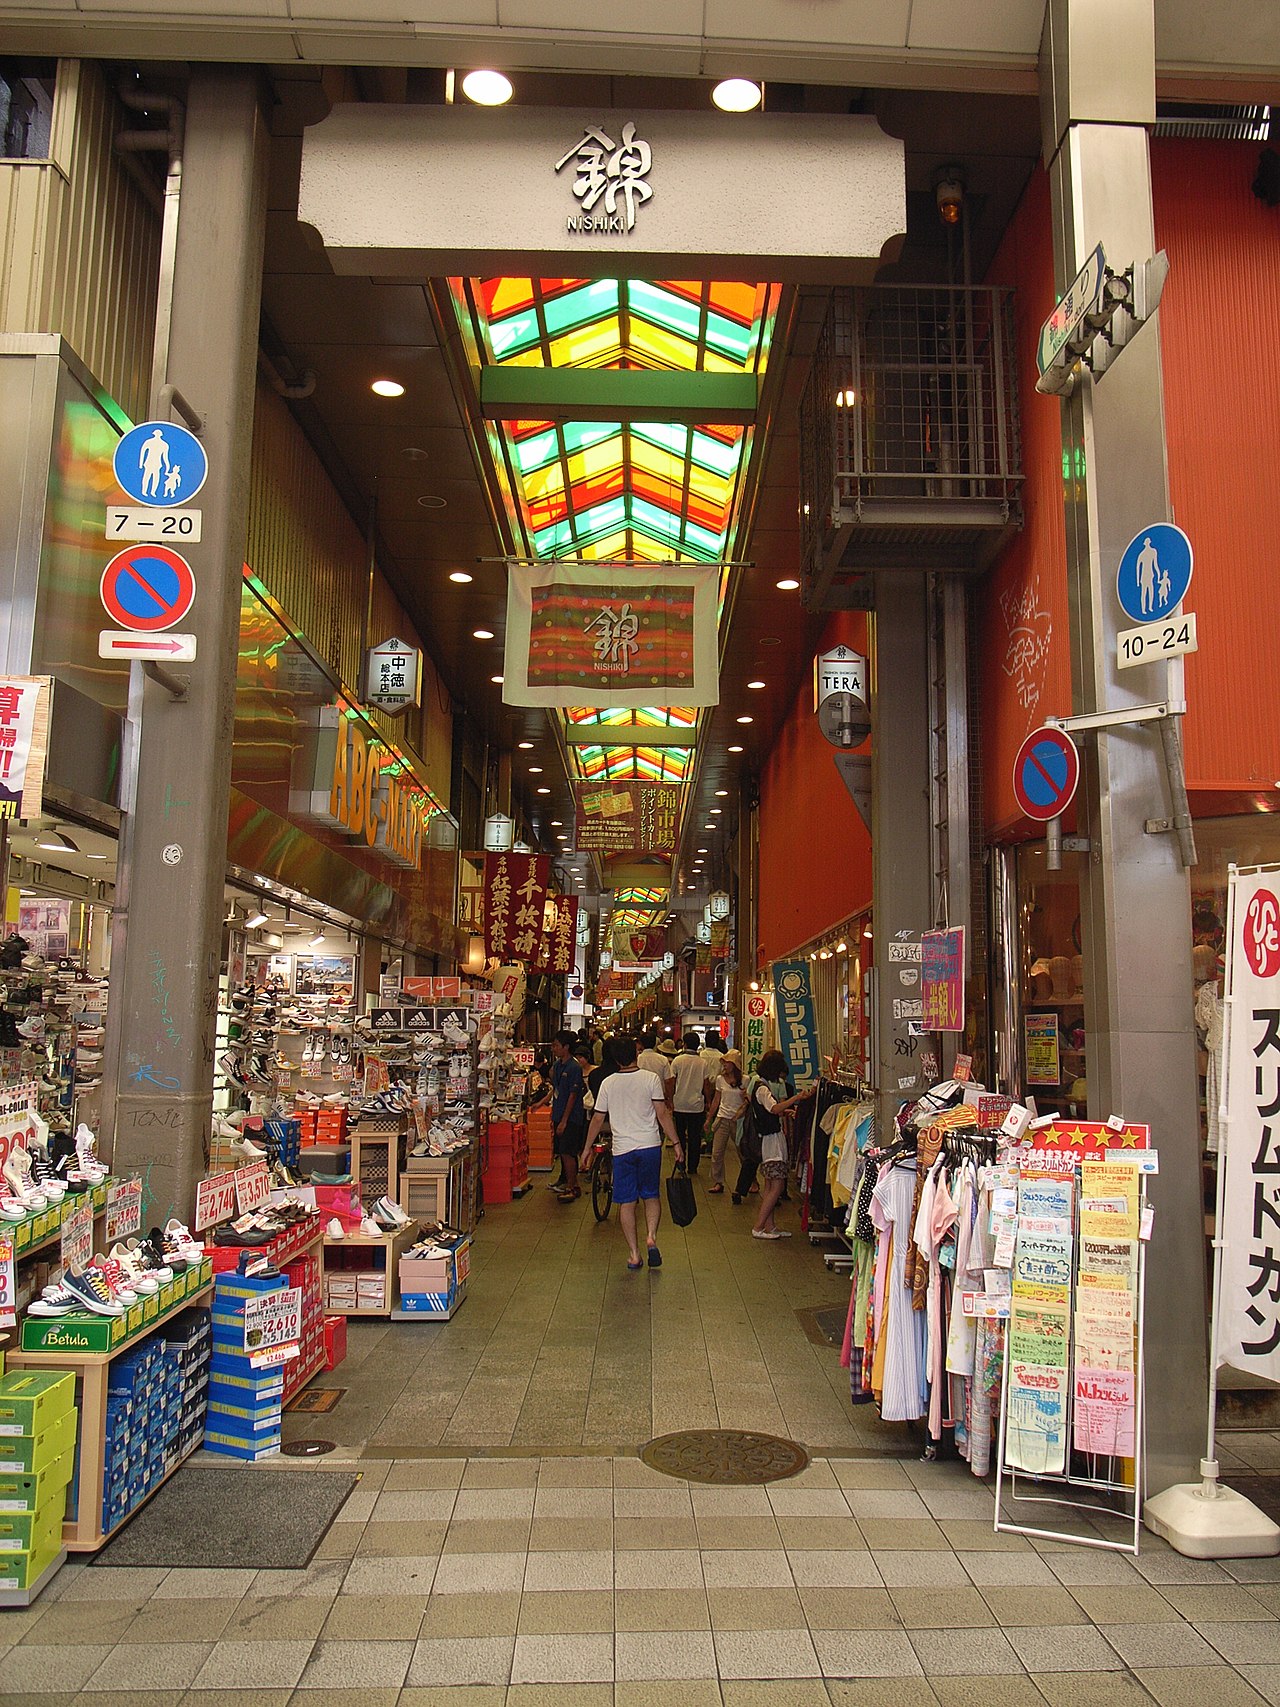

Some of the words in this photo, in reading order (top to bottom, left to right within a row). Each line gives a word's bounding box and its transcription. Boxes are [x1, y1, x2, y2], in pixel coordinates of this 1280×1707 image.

[555, 121, 653, 232] 錦
[584, 603, 639, 673] 錦
[390, 656, 405, 688] 中徳
[594, 662, 624, 671] NISHIKI
[822, 676, 861, 691] TERA
[647, 788, 657, 850] ポイントカード
[657, 789, 677, 850] 錦市場
[47, 1333, 89, 1346] Betula
